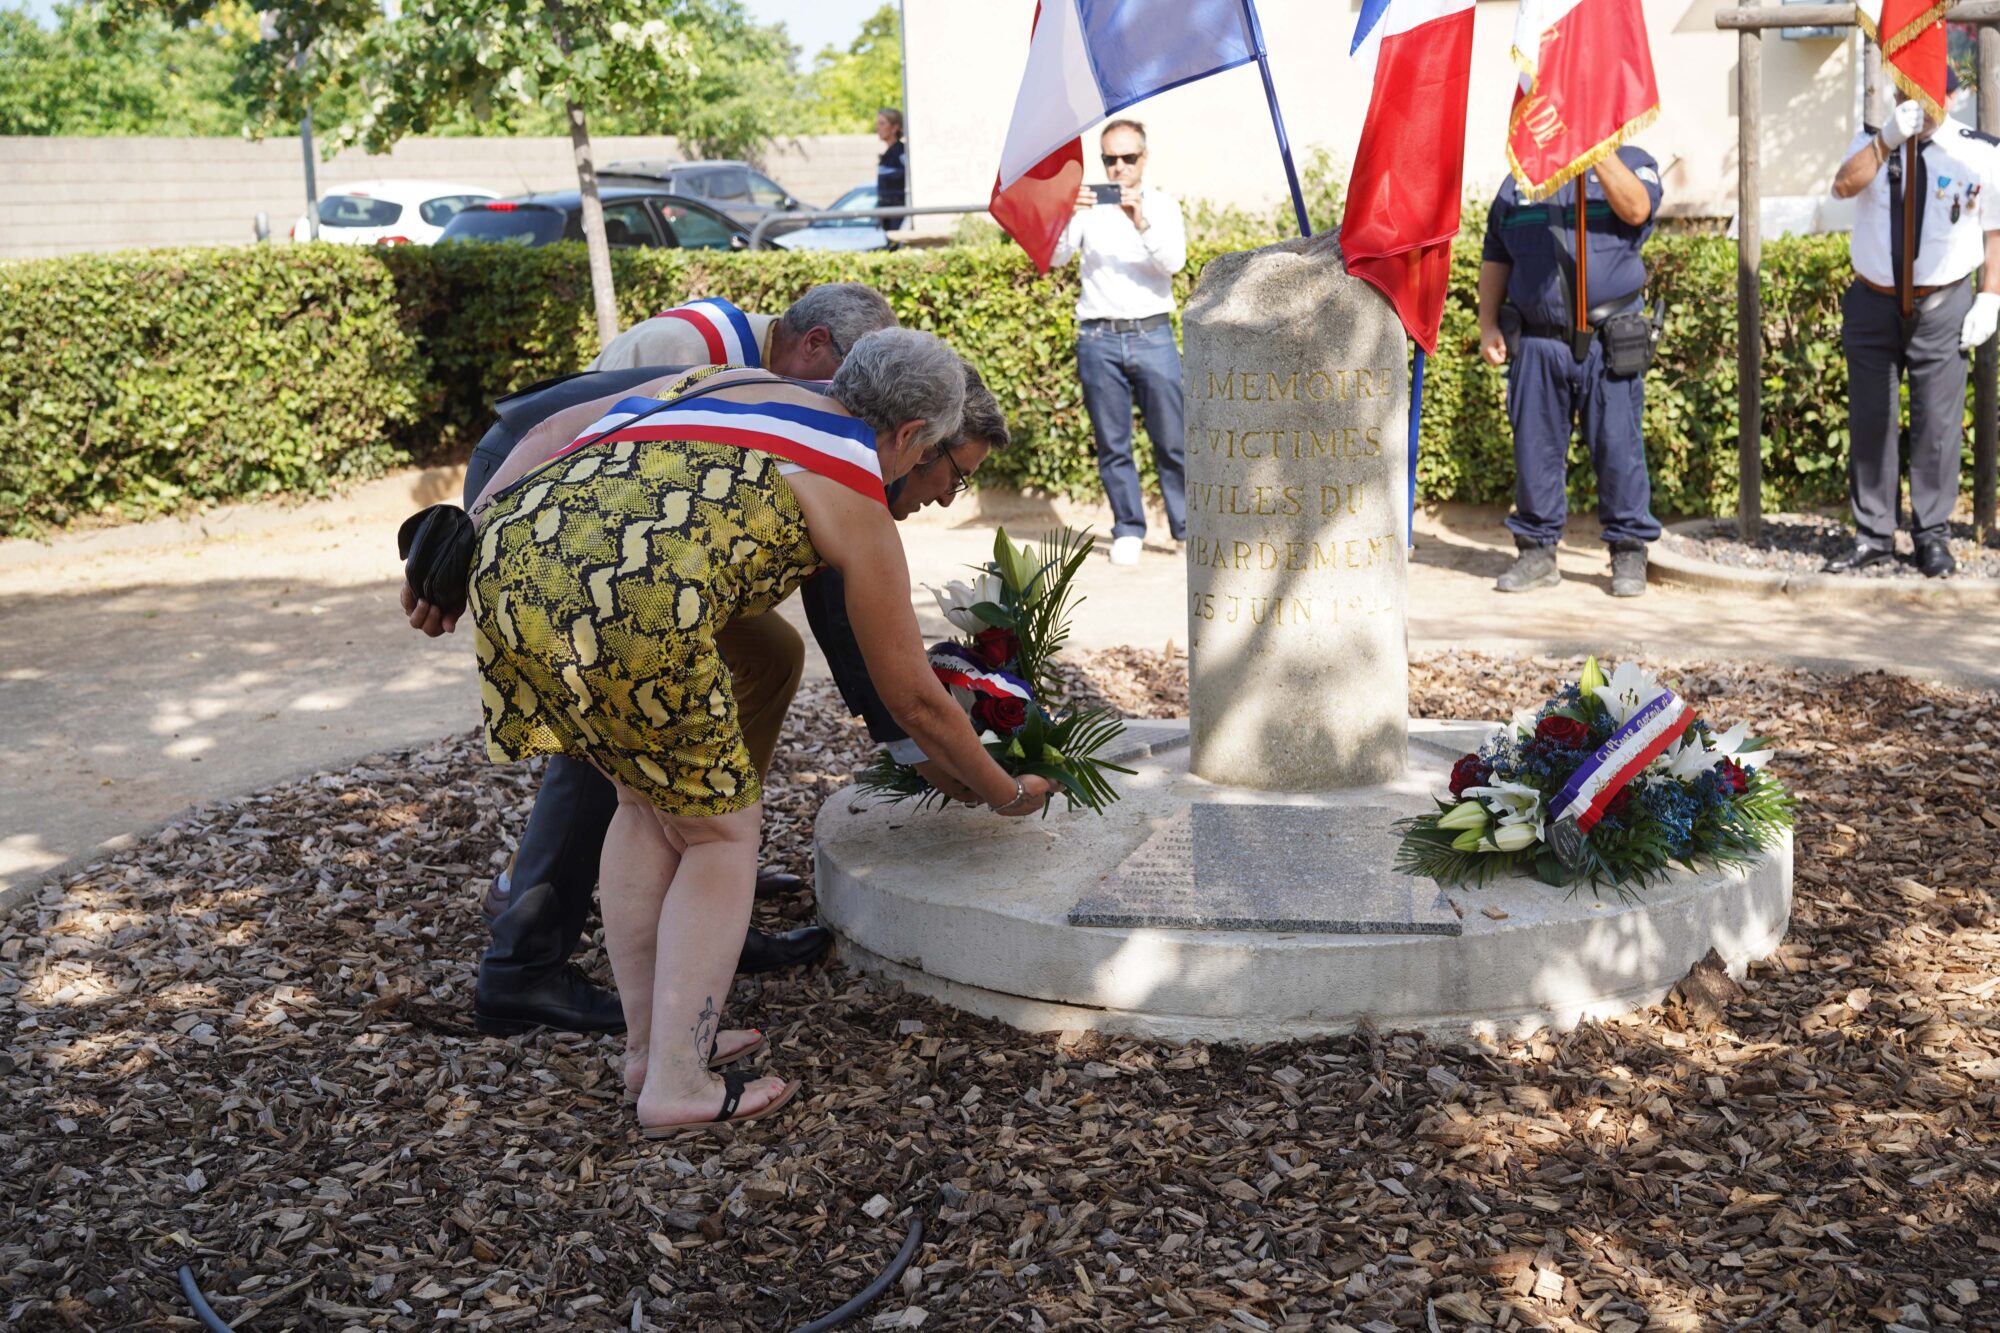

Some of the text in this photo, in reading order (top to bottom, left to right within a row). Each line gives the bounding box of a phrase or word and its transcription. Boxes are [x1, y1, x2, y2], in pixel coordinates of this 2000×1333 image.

[1206, 427, 1383, 460] VICTIMES
[1319, 481, 1365, 517] DU
[1193, 592, 1216, 621] 25
[1225, 593, 1313, 626] JUIN
